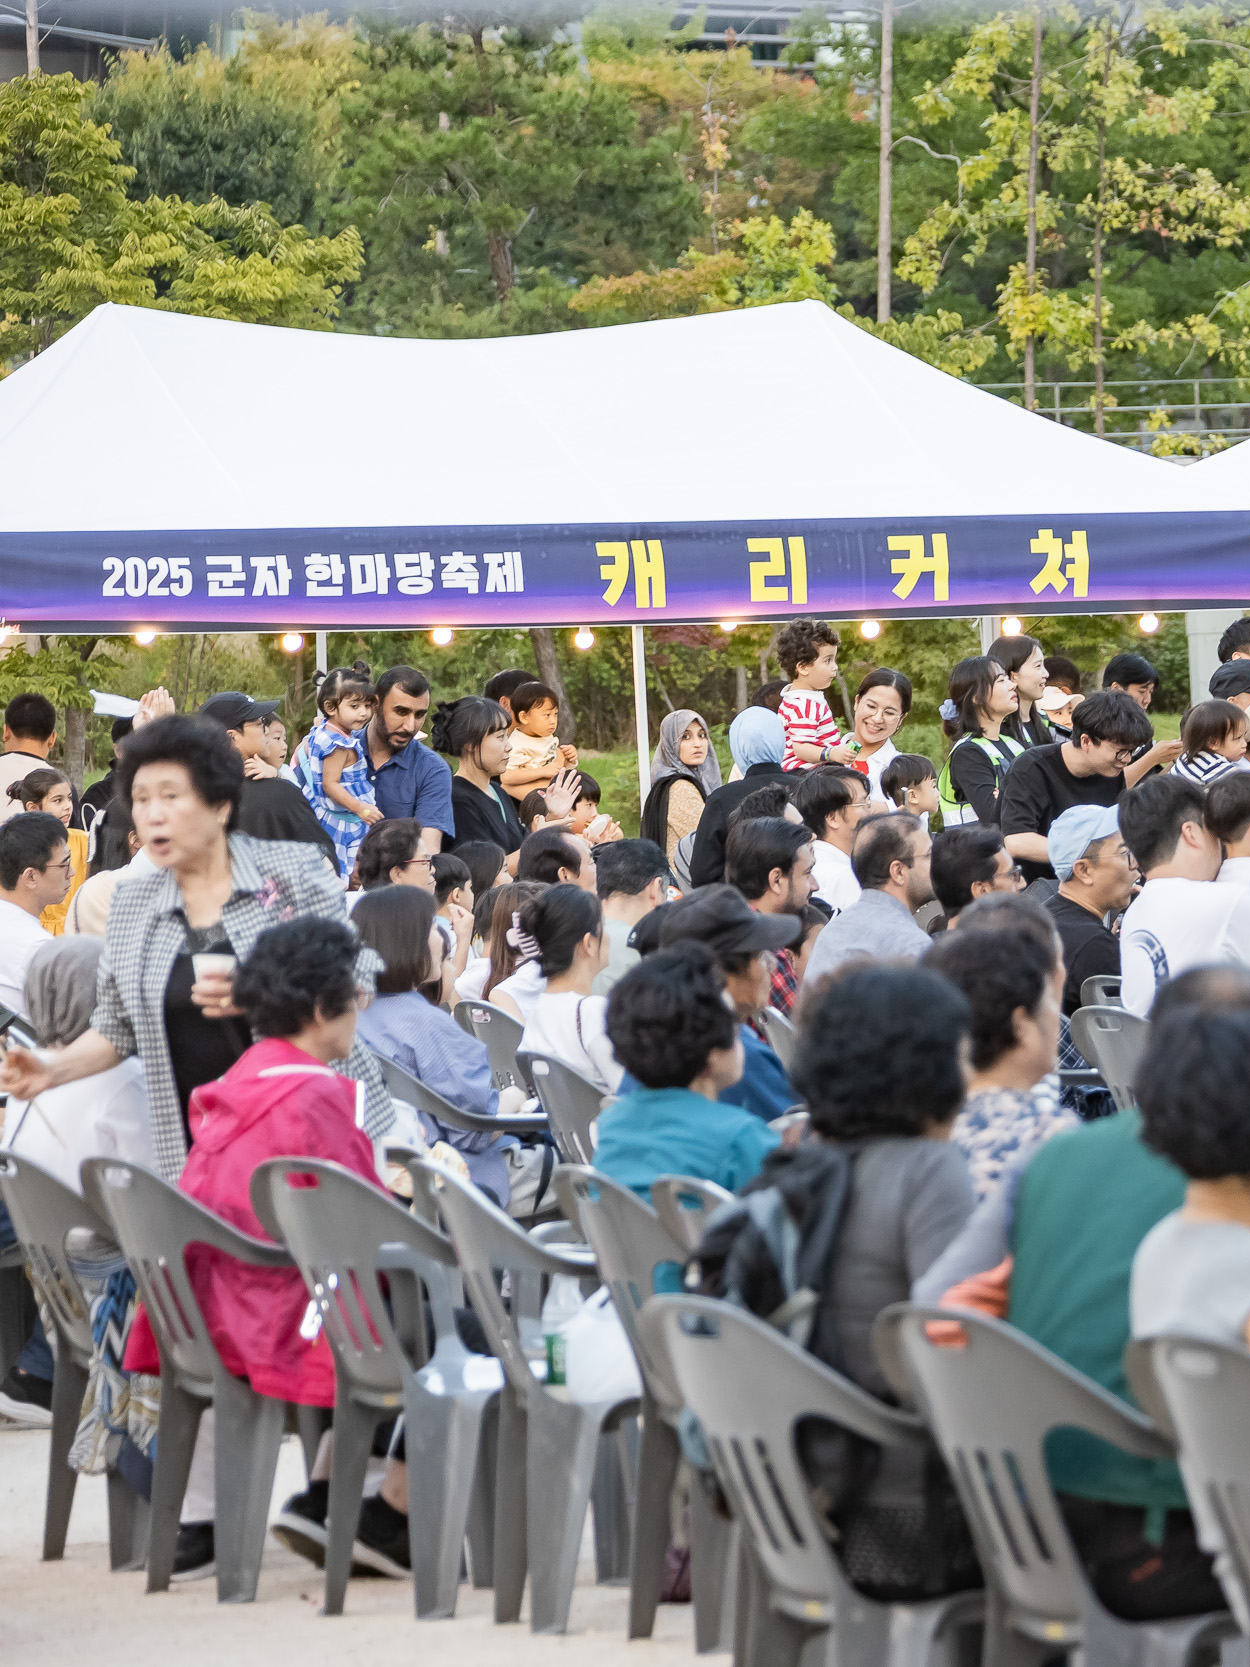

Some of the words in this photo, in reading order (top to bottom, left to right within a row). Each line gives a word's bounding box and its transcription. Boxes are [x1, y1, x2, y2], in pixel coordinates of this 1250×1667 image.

[102, 556, 193, 598] 2025
[205, 554, 293, 597] 군자
[303, 551, 525, 597] 한마당축제
[595, 539, 667, 609] 캐
[746, 536, 808, 604] 리
[887, 533, 949, 601] 커
[1029, 528, 1090, 597] 쳐
